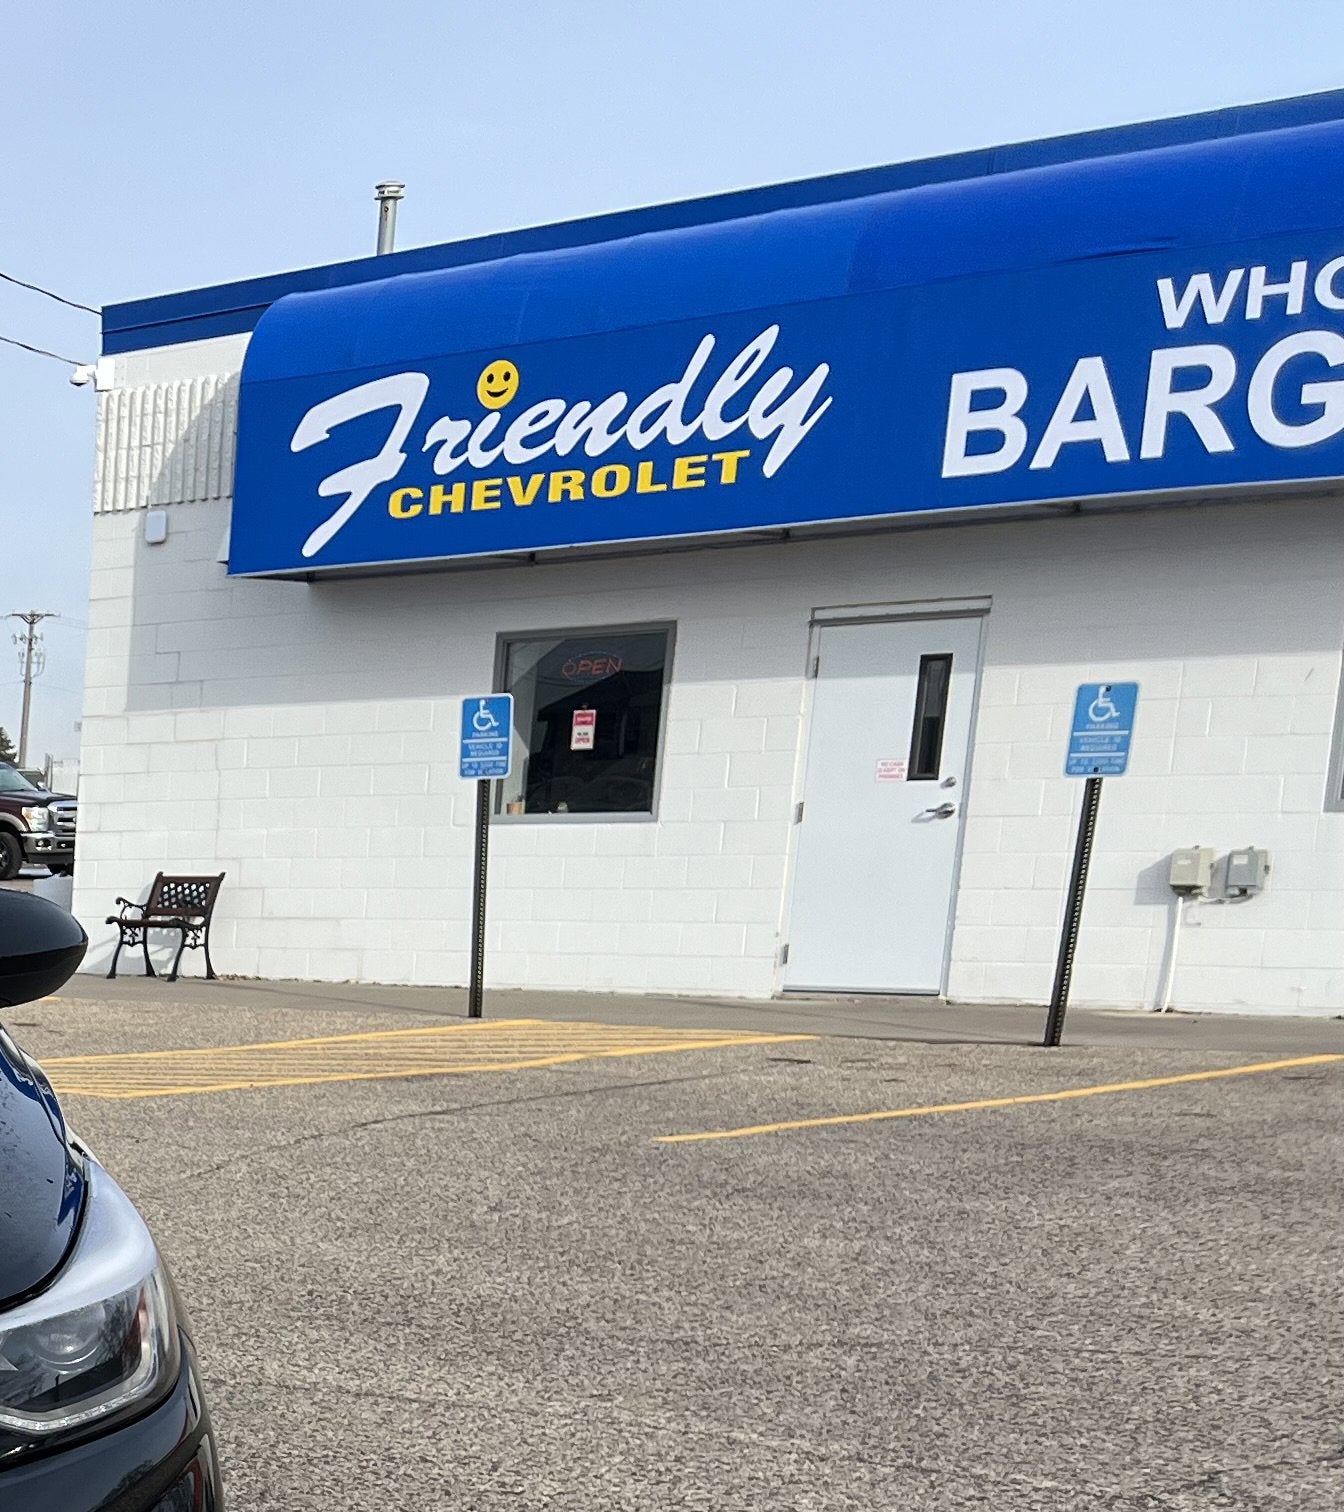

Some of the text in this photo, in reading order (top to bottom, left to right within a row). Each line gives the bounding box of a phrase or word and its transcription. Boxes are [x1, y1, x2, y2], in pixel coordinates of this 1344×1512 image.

[291, 324, 832, 558] Friendly
[941, 330, 1344, 479] BARG
[388, 449, 750, 519] CHEVROLET
[561, 656, 624, 679] OPEN
